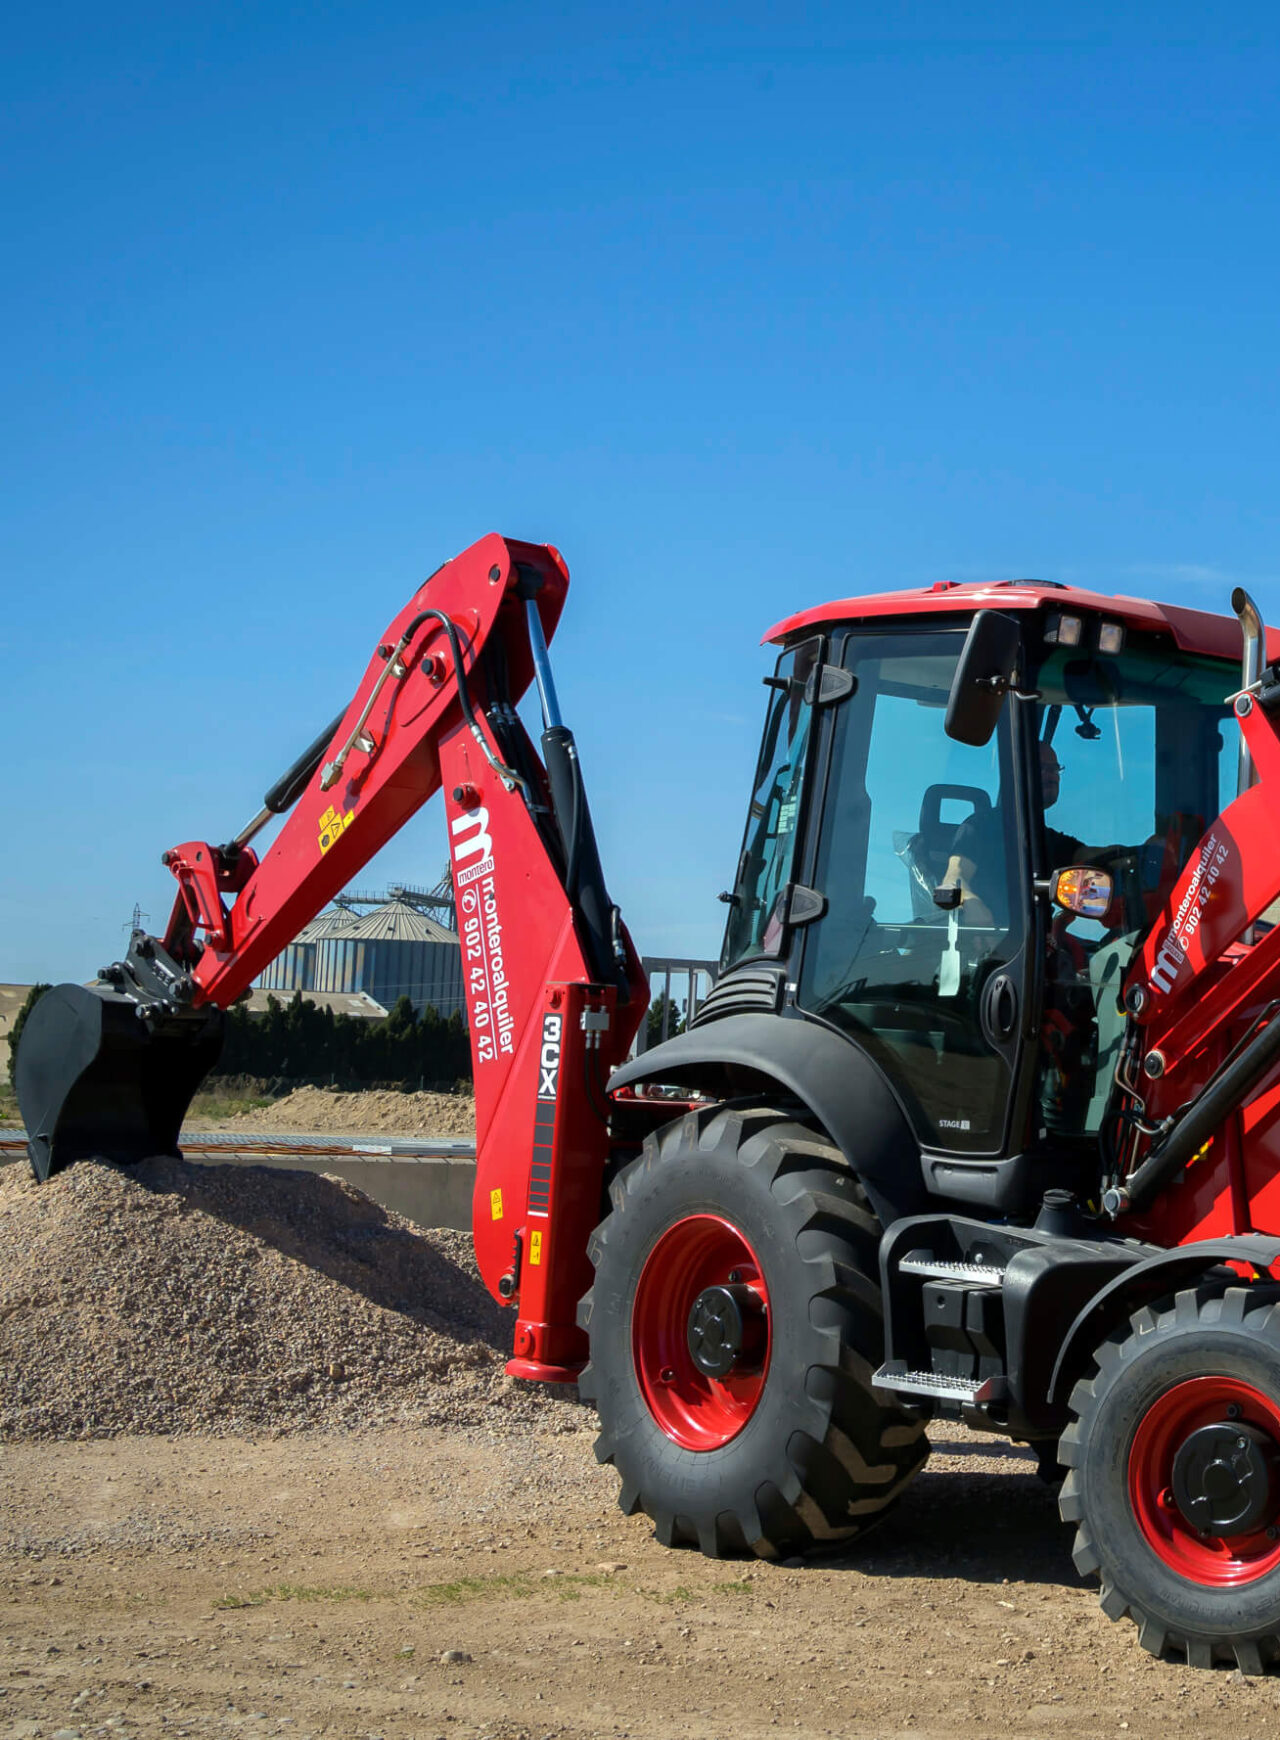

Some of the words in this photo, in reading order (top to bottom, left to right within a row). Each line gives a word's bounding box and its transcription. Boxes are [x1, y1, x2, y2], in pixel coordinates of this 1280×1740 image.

[458, 858, 494, 885] montero
[1168, 833, 1217, 942] monteroalquiler
[1185, 906, 1203, 935] 902
[1198, 887, 1212, 907] 42
[1206, 866, 1221, 886] 40
[1215, 845, 1229, 865] 42
[464, 917, 482, 961] 902
[470, 967, 486, 995] 42
[482, 876, 515, 1054] monteroalquiler
[473, 1001, 490, 1028] 40
[477, 1035, 494, 1063] 42
[538, 1015, 562, 1095] 3CX
